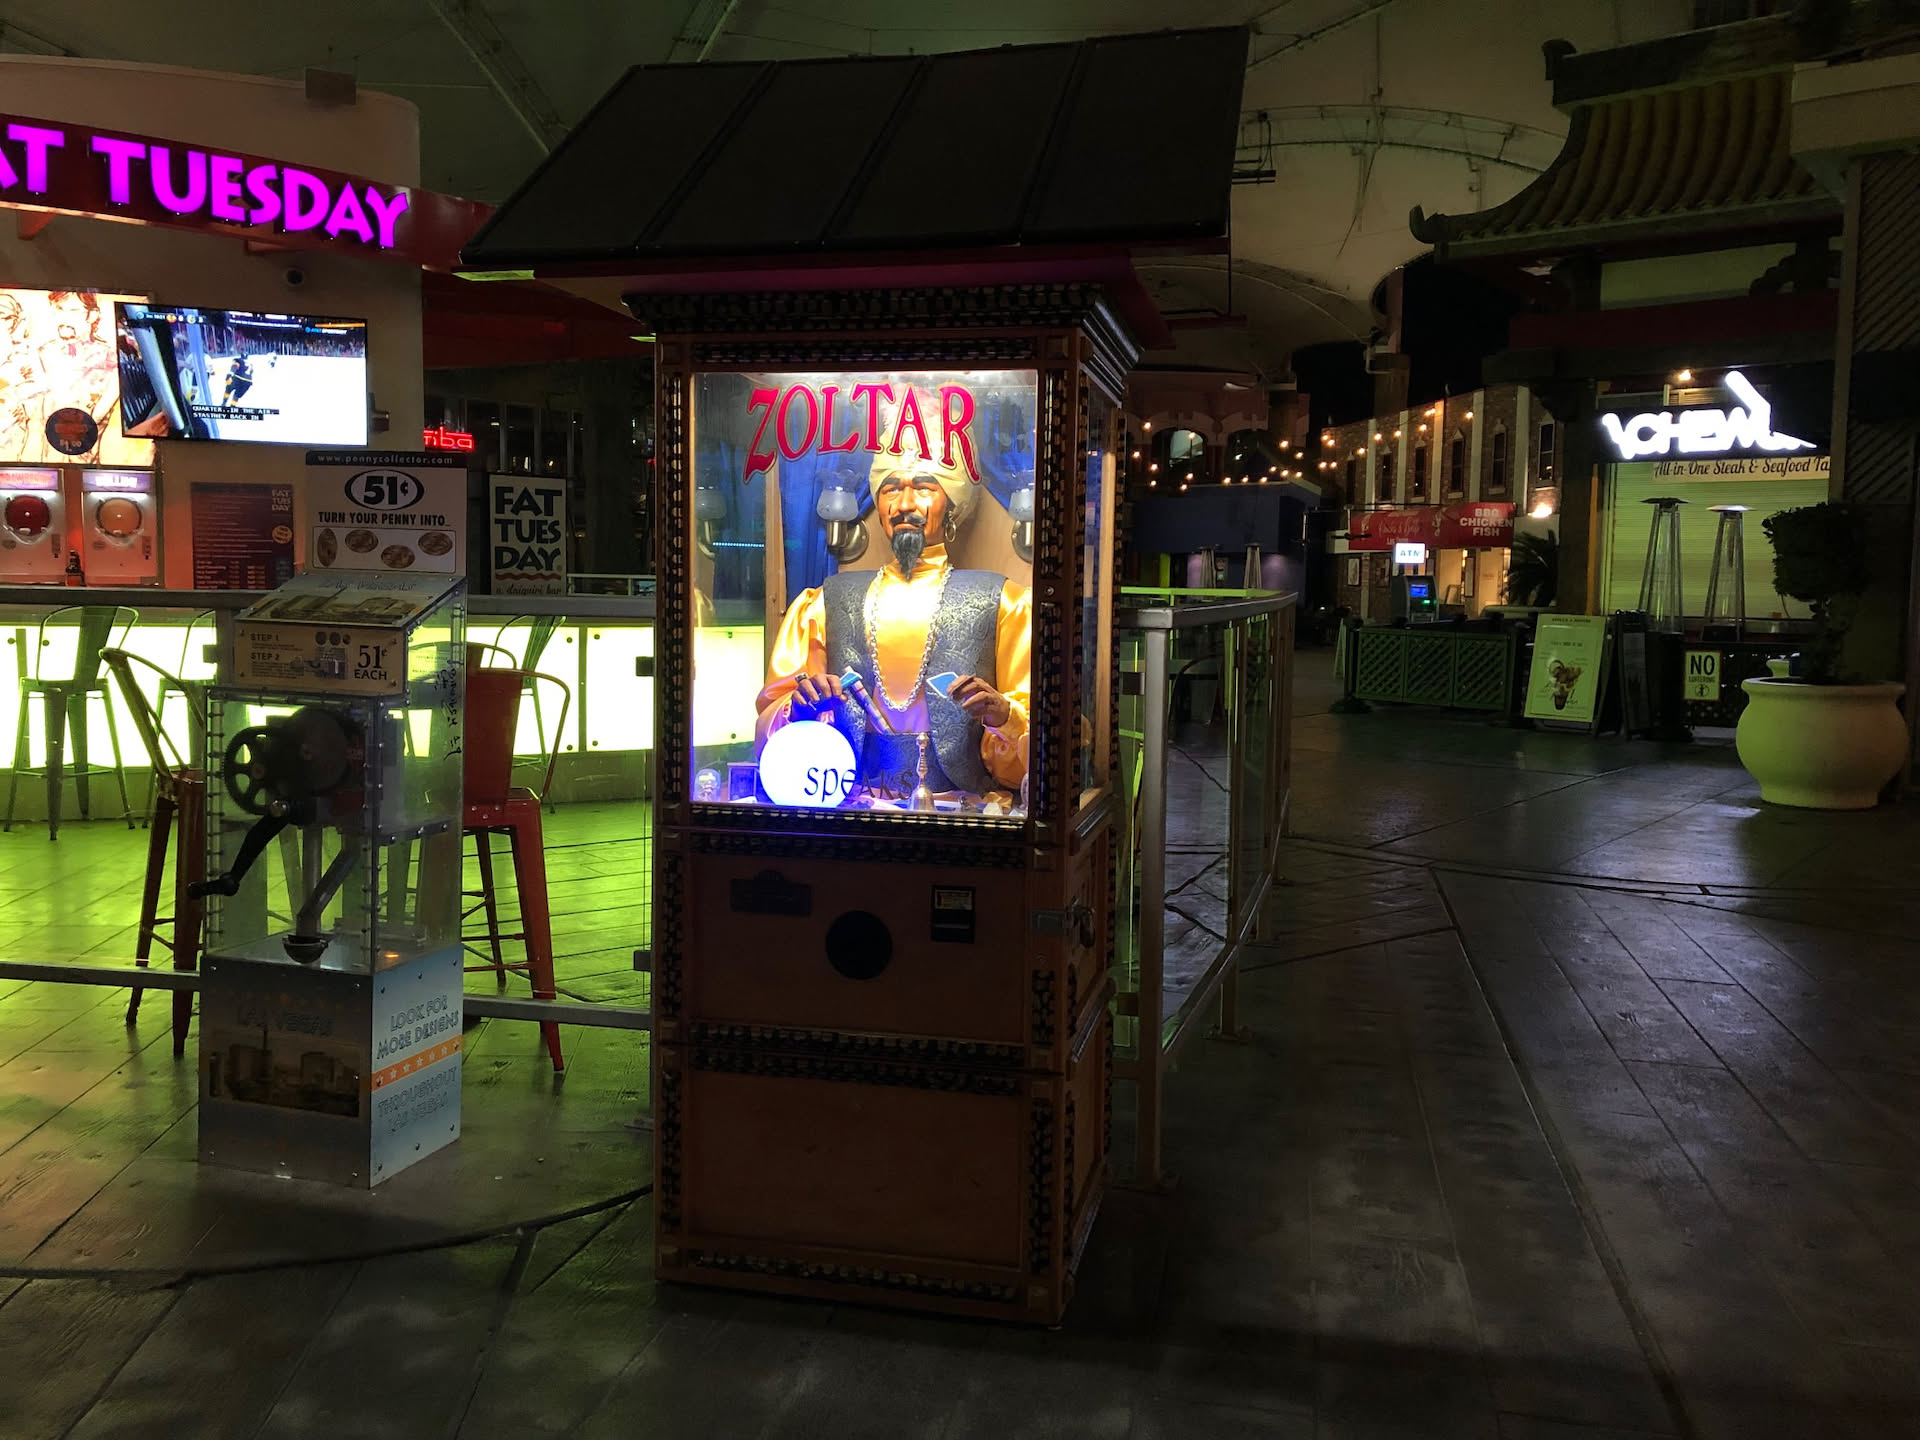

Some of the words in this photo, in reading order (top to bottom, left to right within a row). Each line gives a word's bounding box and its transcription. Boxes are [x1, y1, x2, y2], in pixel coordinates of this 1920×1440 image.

[92, 135, 409, 248] TUESDAY
[743, 380, 983, 484] ZOLTAR
[317, 455, 453, 464] www.pennycollector.com
[1655, 460, 1709, 477] All-in-One
[1713, 459, 1745, 475] Steak
[1748, 458, 1759, 473] &
[1762, 456, 1811, 477] Seafood
[363, 475, 408, 505] 51¢
[495, 487, 562, 516] FAT
[318, 511, 346, 523] TURN
[349, 513, 378, 524] YOUR
[381, 514, 417, 525] PENNY
[1460, 517, 1513, 527] CHICKEN
[1475, 508, 1500, 517] BBQ
[495, 518, 561, 544] TUES
[1473, 527, 1500, 537] FISH
[495, 546, 561, 571] DAY
[250, 632, 273, 642] STEP
[250, 652, 273, 661] STEP
[275, 652, 281, 662] 2
[1690, 655, 1715, 675] NO
[354, 669, 387, 681] EACH
[390, 1003, 426, 1032] LOOK
[426, 994, 448, 1017] FOR
[376, 1030, 412, 1060] MORE
[414, 1009, 459, 1043] DESIGNS
[377, 1065, 458, 1118] THROUGHOUT
